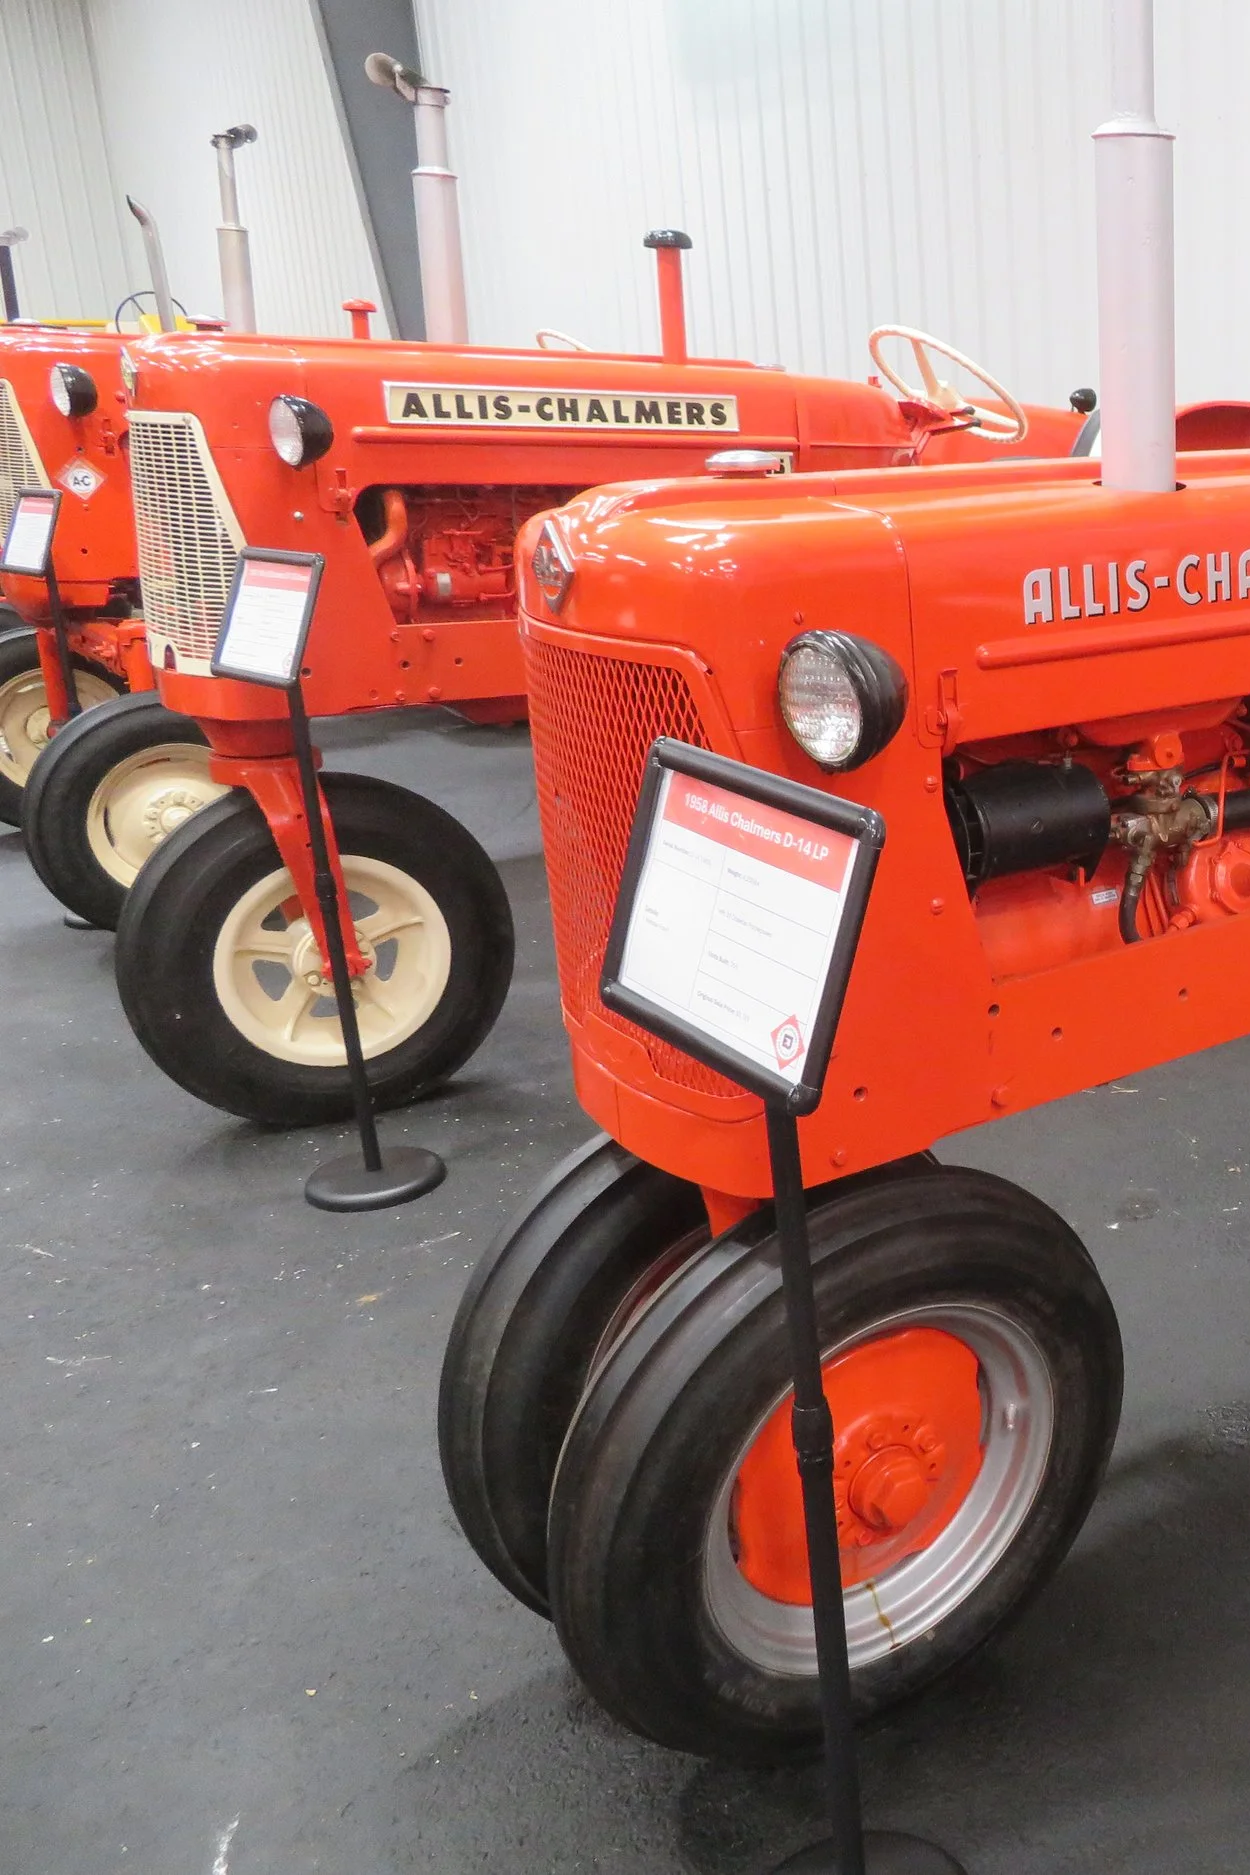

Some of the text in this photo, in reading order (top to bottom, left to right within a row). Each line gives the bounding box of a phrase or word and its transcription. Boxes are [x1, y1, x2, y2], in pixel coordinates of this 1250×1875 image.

[401, 392, 727, 426] ALLIS-CHALMERS
[684, 792, 709, 814] 1958
[708, 802, 729, 824] Allis
[730, 811, 782, 845] Chalmers
[812, 845, 830, 861] LP
